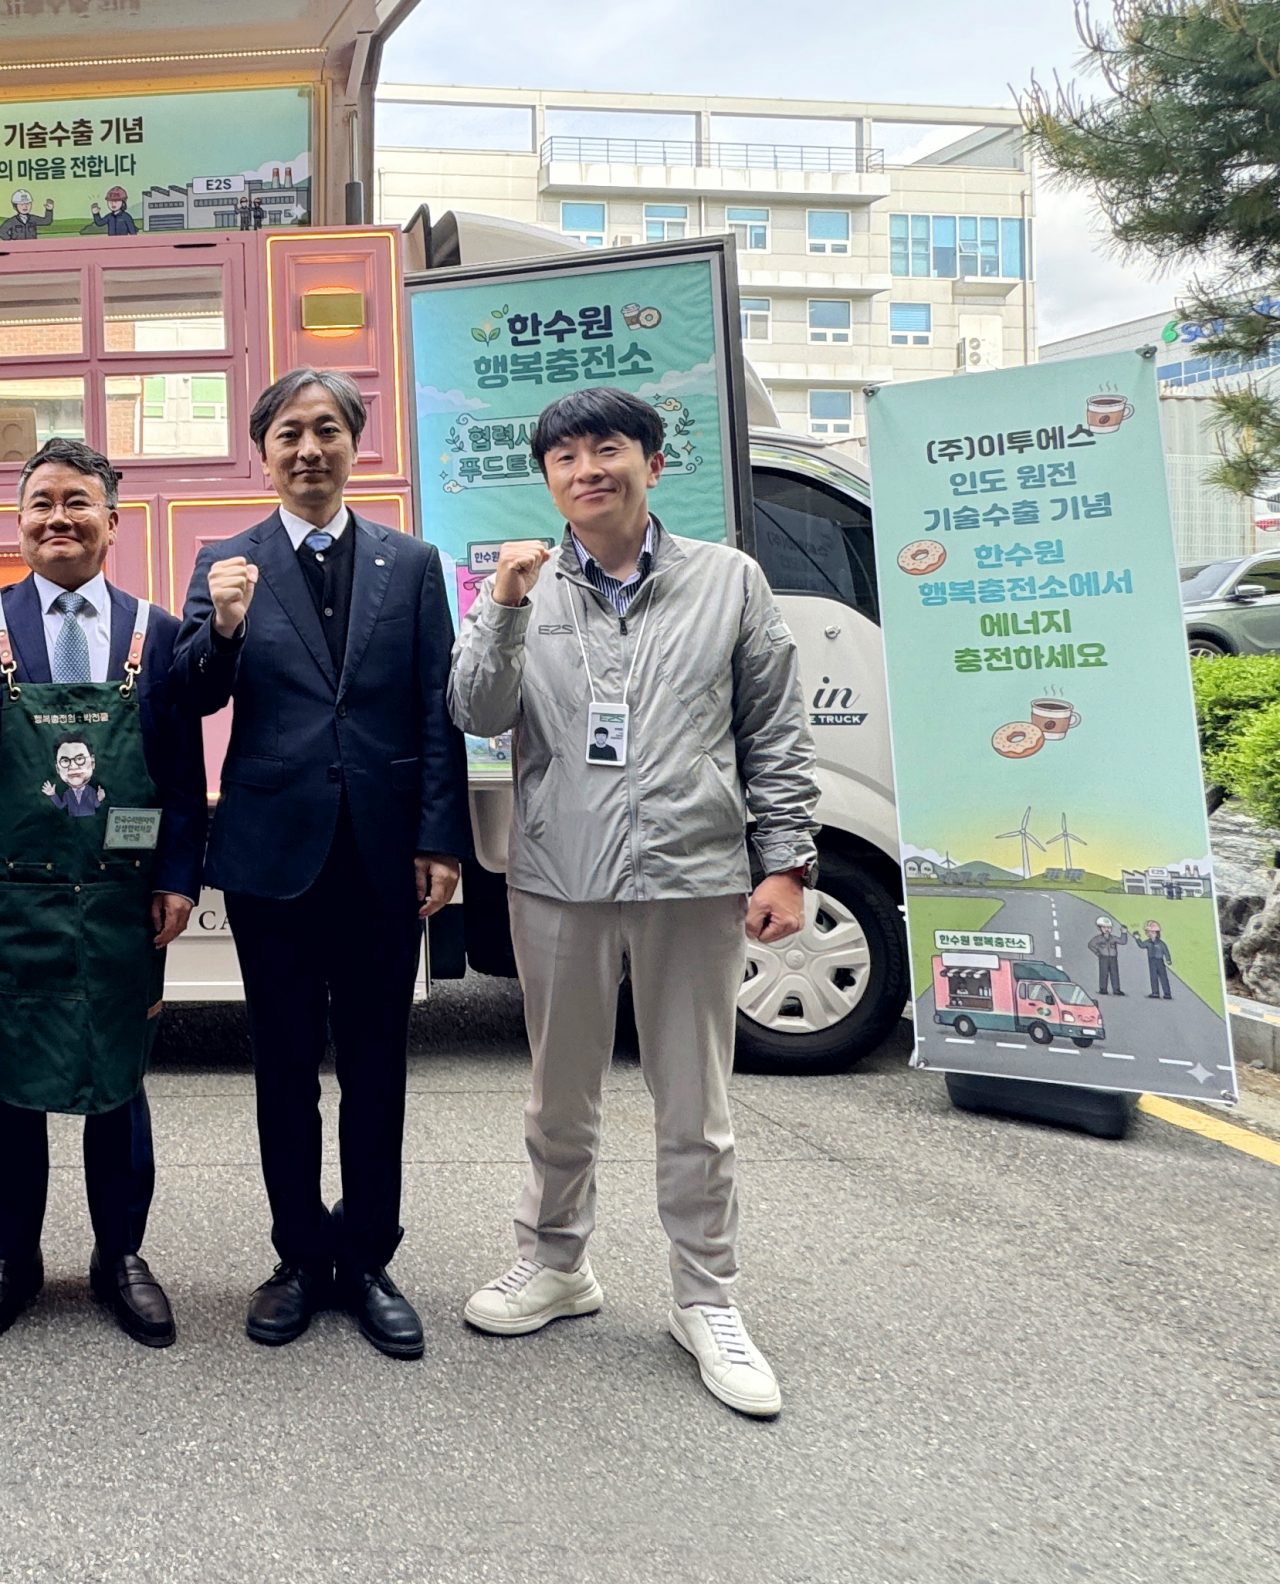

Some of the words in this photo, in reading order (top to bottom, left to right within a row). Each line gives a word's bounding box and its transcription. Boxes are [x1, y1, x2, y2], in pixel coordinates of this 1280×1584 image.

[4, 119, 94, 149] 기술수출
[100, 117, 144, 144] 기념
[18, 156, 66, 181] 마음을
[70, 153, 136, 178] 전합니다
[205, 179, 232, 191] E2S
[506, 304, 614, 347] 한수원
[473, 342, 655, 390] 행복충전소
[926, 423, 1098, 464] (주)이투에스
[948, 468, 1008, 496] 인도
[1016, 461, 1078, 489] 원전
[923, 499, 1041, 532] 기술수출
[1051, 492, 1112, 521] 기념
[973, 539, 1065, 569] 한수원
[918, 569, 1134, 607] 행복충전소에서
[980, 608, 1073, 637] 에너지
[953, 641, 1109, 673] 충전하세요
[818, 715, 861, 724] TRUCK
[938, 934, 970, 946] 한수원
[972, 936, 1027, 949] 행복충전소
